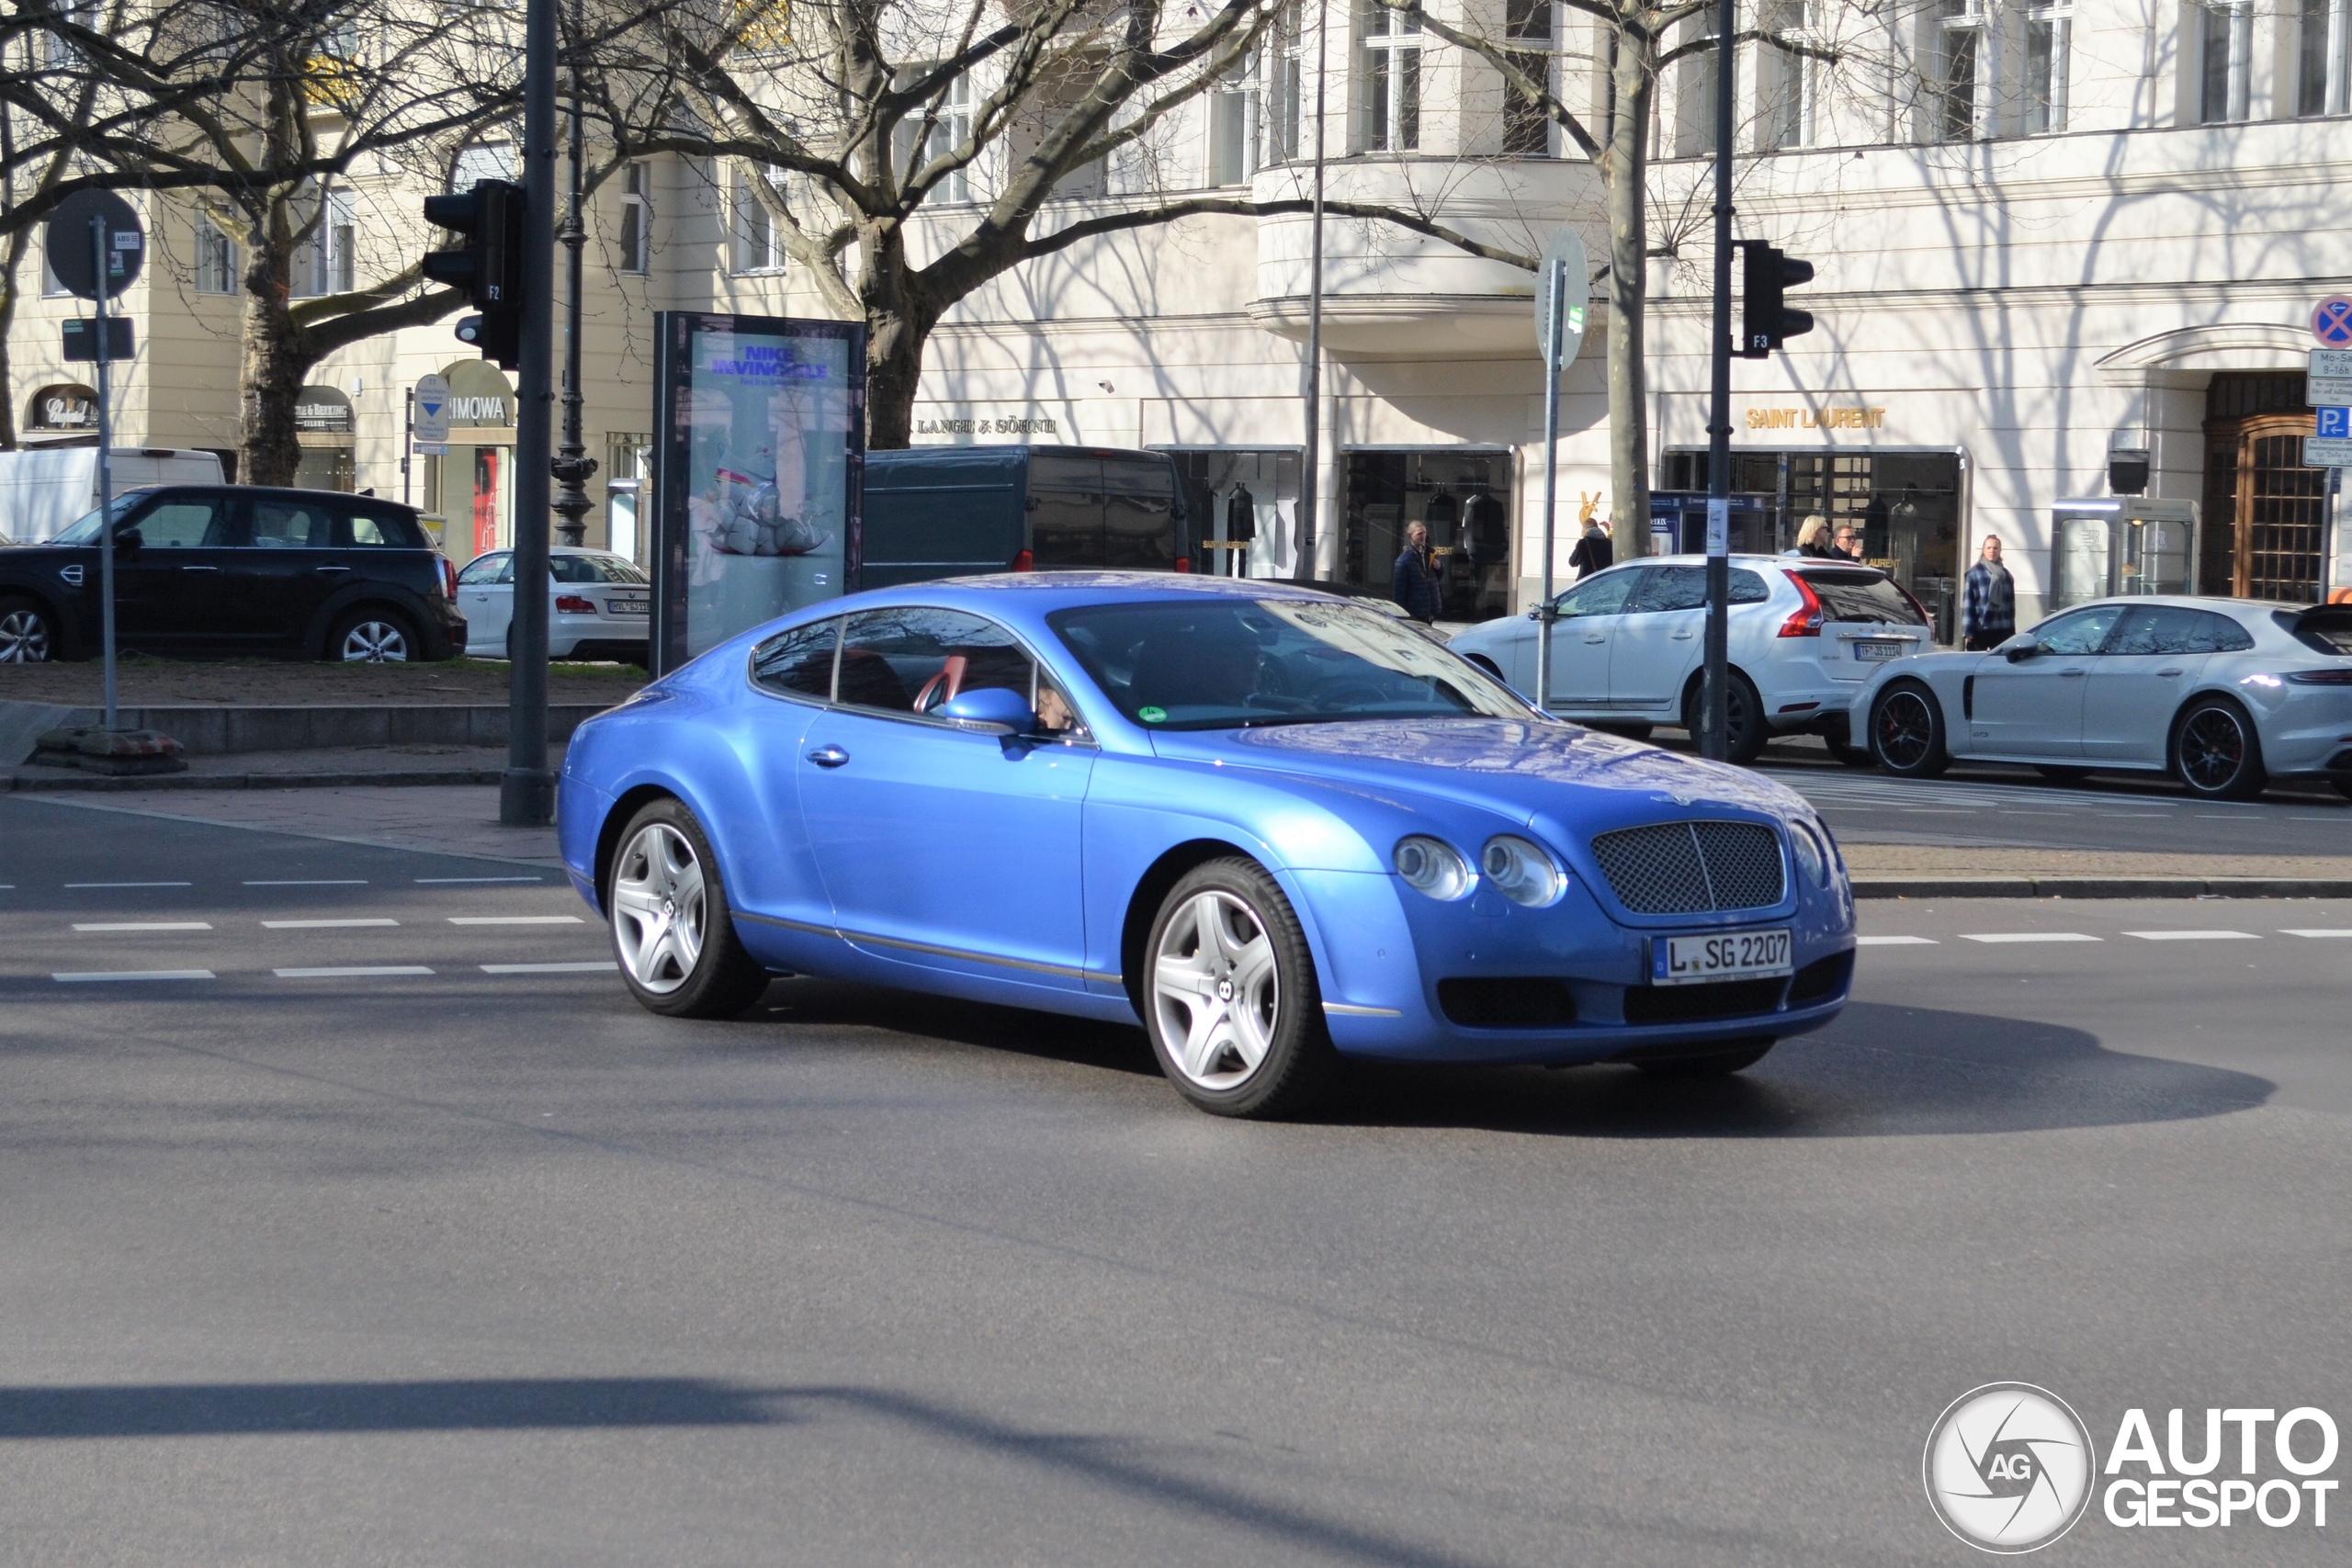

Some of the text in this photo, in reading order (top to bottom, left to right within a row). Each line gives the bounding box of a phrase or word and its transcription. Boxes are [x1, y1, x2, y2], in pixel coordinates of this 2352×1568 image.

[490, 286, 500, 299] F2
[1754, 335, 1767, 348] F3
[746, 346, 794, 362] NIKE
[712, 360, 826, 378] INVINCIBLE
[917, 415, 1057, 434] LANGE & SÖHNE
[1746, 408, 1886, 429] SAINT LAURENT
[2322, 410, 2339, 434] P
[1861, 646, 1871, 656] TF
[1669, 933, 1788, 972] L SG 2207
